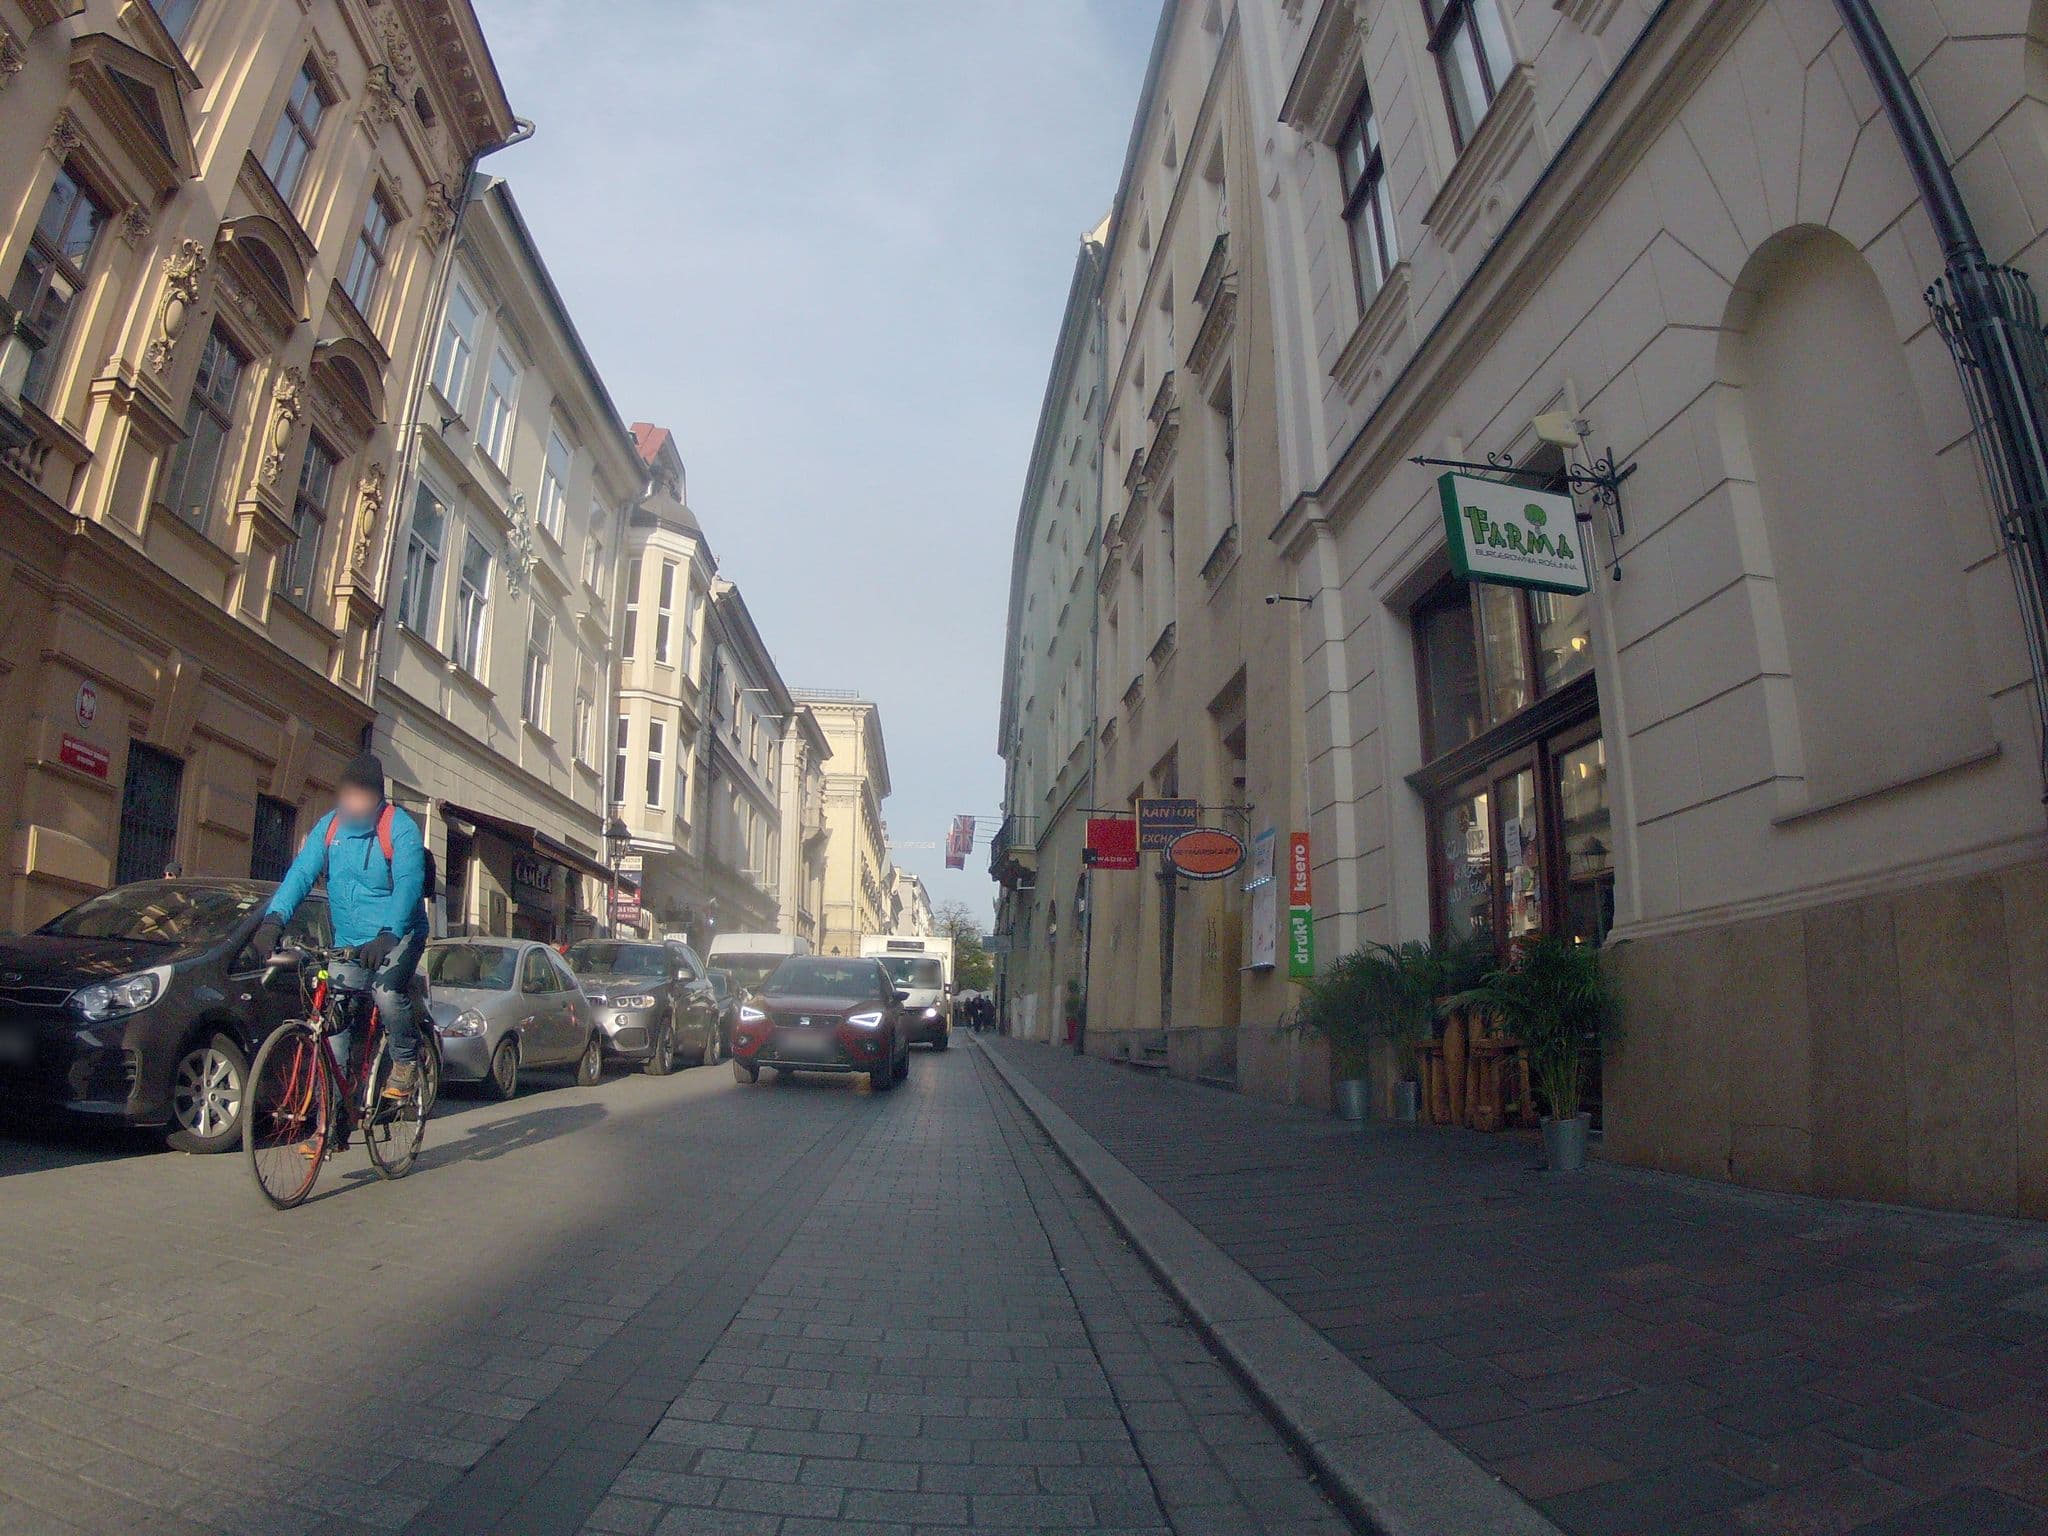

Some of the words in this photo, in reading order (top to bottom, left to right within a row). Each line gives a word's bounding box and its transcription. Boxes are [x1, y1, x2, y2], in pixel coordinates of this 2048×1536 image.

[1463, 506, 1574, 559] FARMA
[1142, 806, 1195, 818] KANTOR
[1294, 844, 1307, 892] ksero
